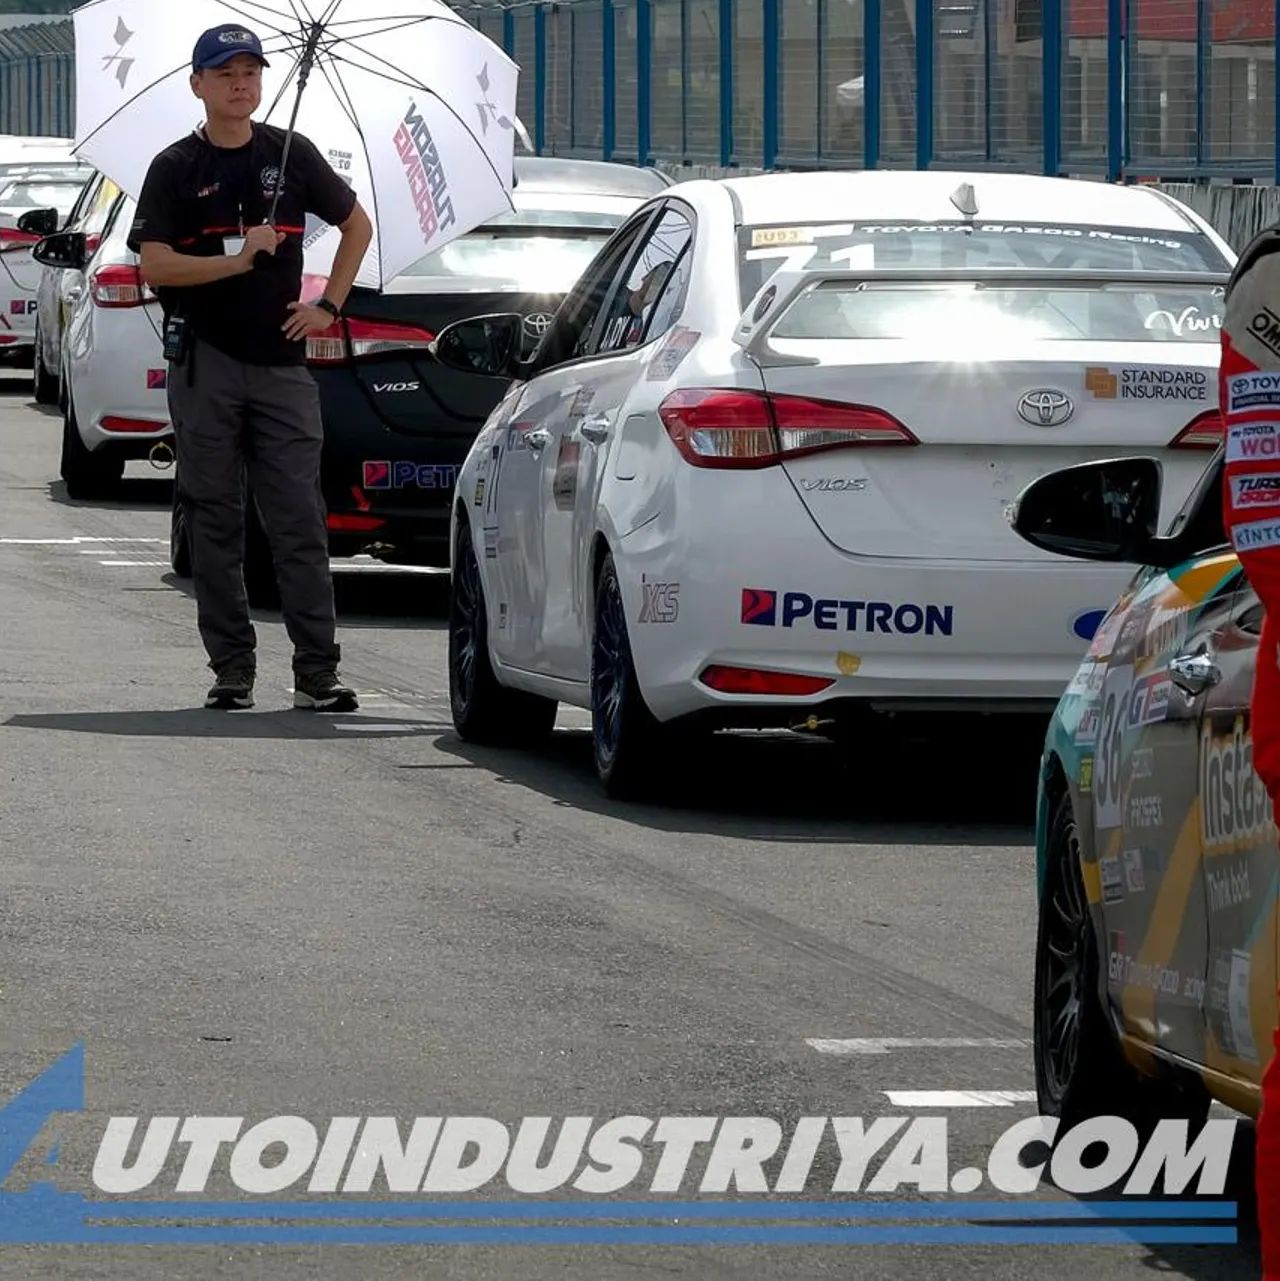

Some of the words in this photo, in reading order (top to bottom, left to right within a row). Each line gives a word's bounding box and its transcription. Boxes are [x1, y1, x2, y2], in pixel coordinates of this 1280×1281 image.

[860, 225, 975, 234] TOYOTA
[981, 224, 1082, 236] GAZOO
[1089, 230, 1182, 249] Racing
[1121, 369, 1207, 385] STANDARD
[372, 381, 420, 393] VIOS
[1121, 385, 1207, 400] INSURANCE
[393, 461, 460, 488] PET
[800, 477, 869, 491] VIOS
[782, 591, 954, 636] PETRON
